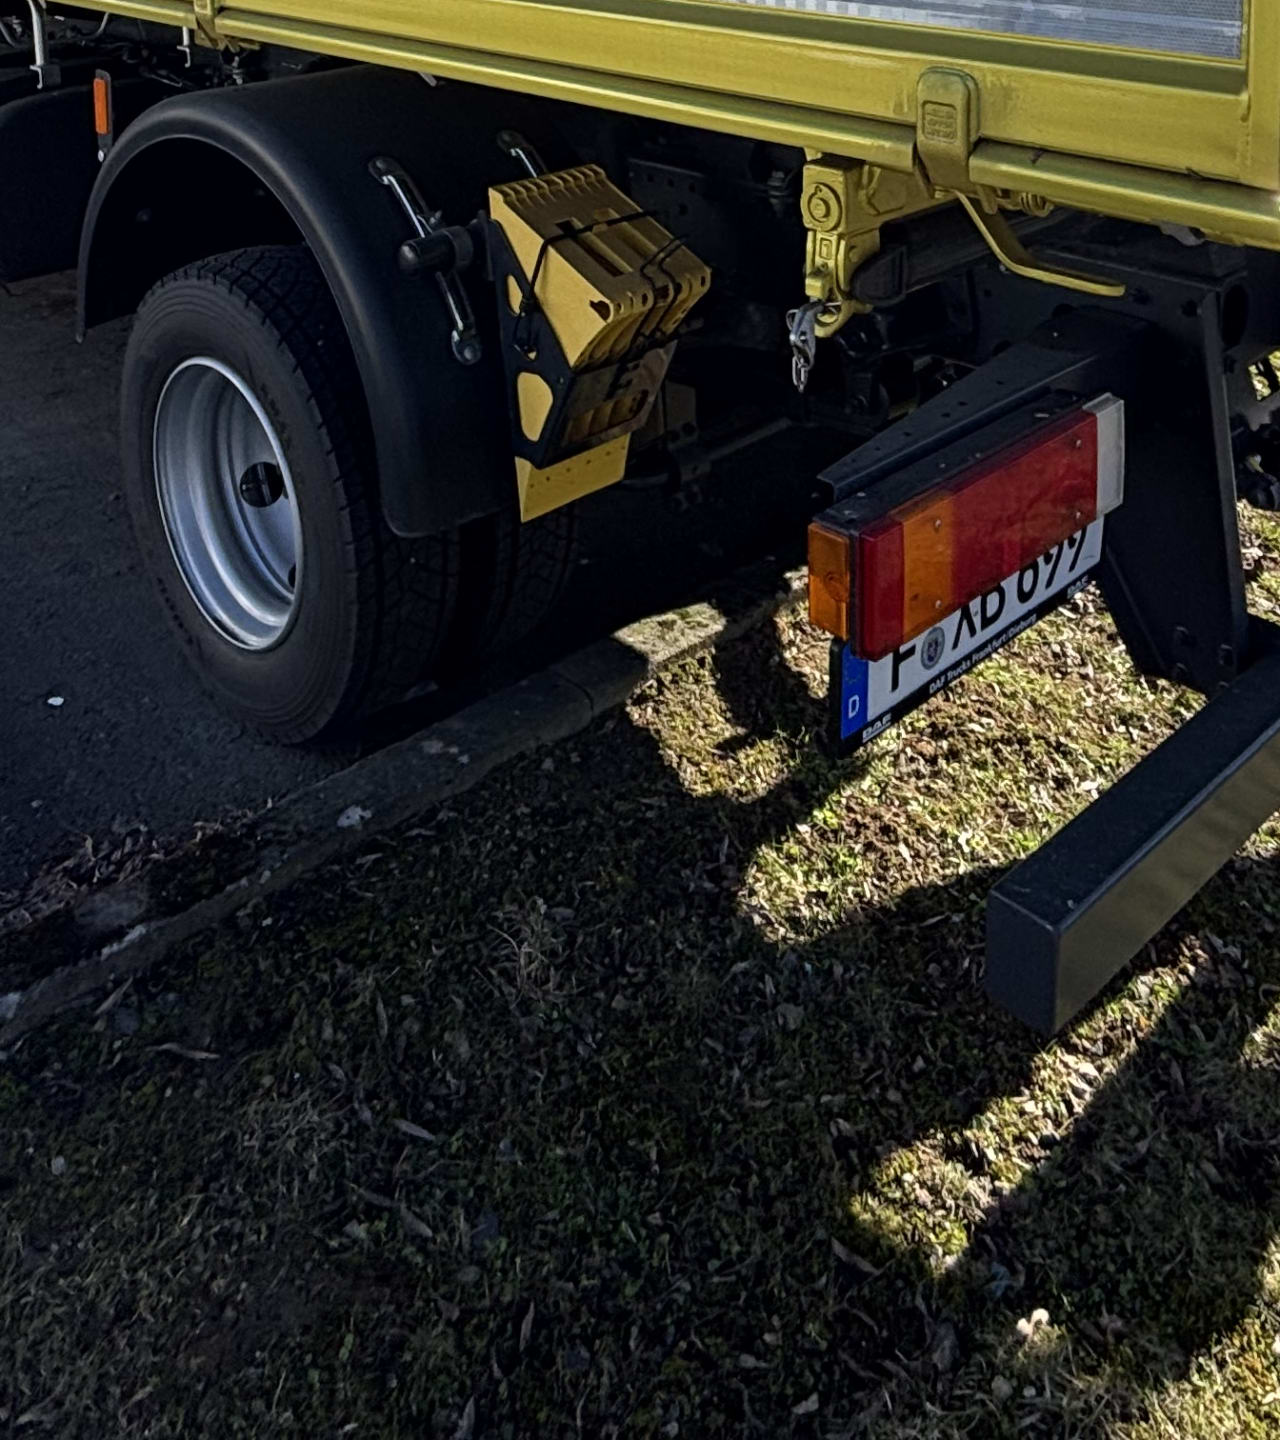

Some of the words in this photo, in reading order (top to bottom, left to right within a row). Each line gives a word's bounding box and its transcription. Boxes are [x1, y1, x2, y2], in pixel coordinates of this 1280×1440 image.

[929, 677, 946, 694] DAF
[946, 661, 971, 683] Trucks
[848, 694, 860, 719] D
[862, 713, 892, 744] DAF
